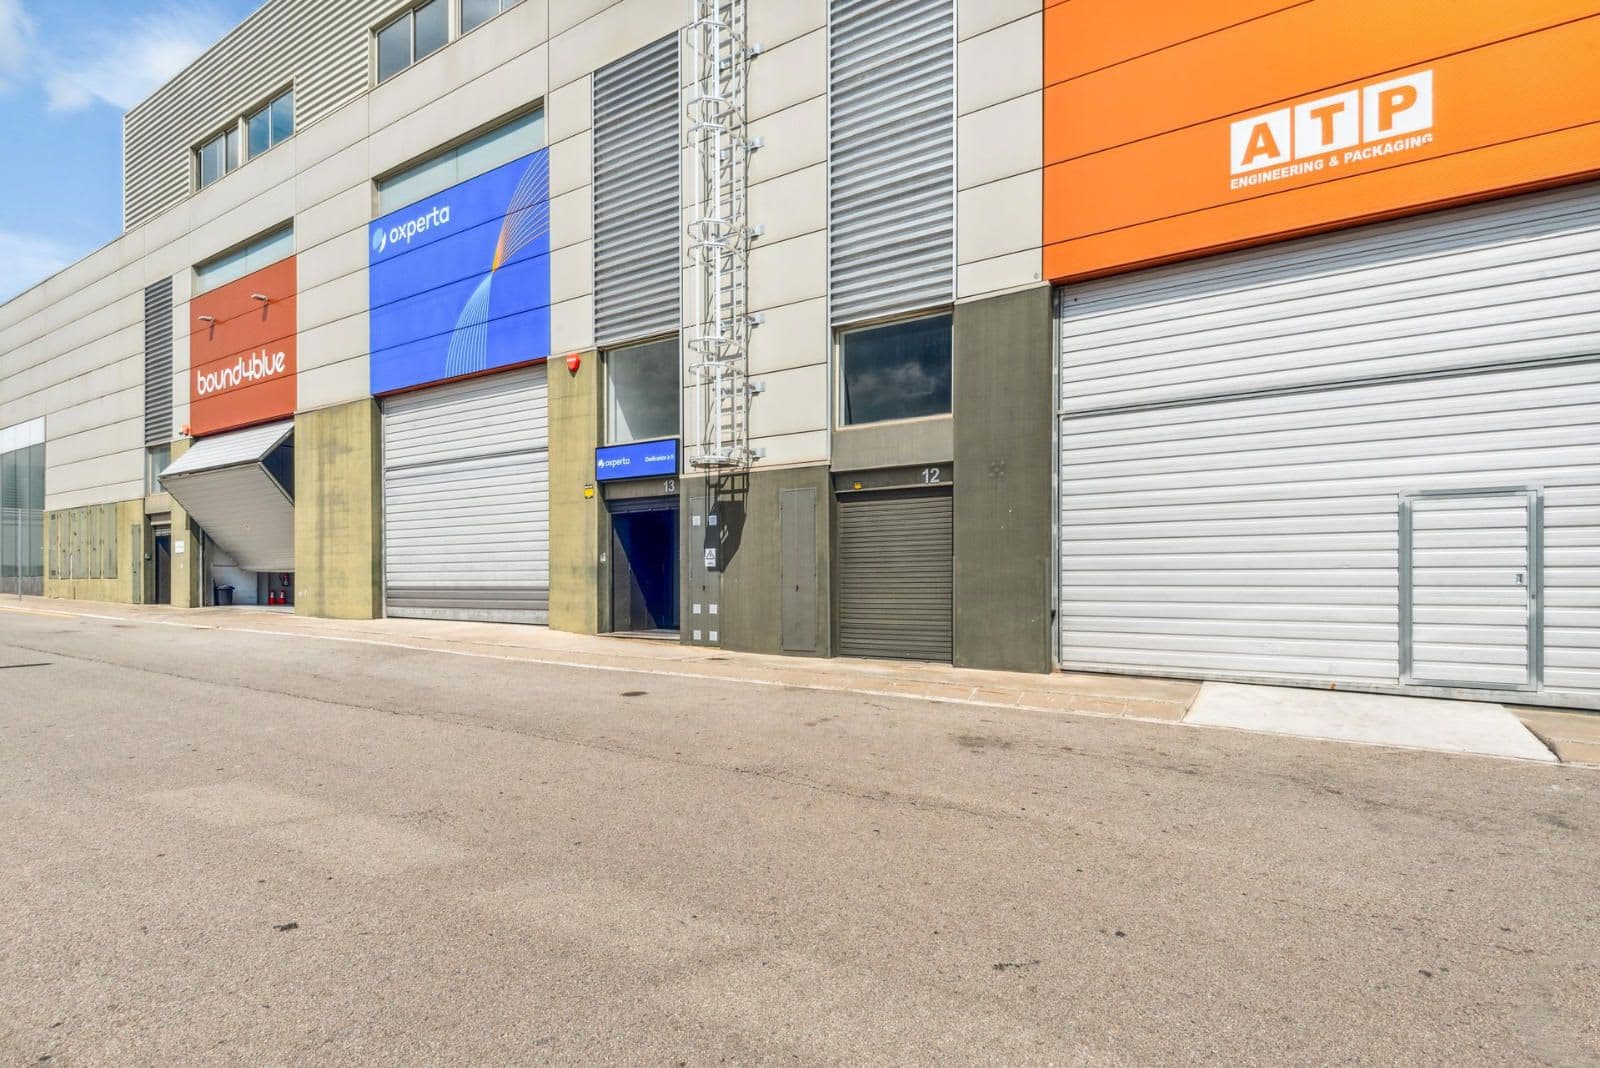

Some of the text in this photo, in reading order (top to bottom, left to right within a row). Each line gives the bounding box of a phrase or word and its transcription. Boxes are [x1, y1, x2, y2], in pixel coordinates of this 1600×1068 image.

[1237, 80, 1422, 168] ATP
[1231, 133, 1433, 190] ENGINEERING & PACKAGING
[389, 206, 450, 244] oxperta
[197, 349, 285, 395] bound4blue
[664, 480, 675, 492] 13
[922, 468, 940, 483] 12
